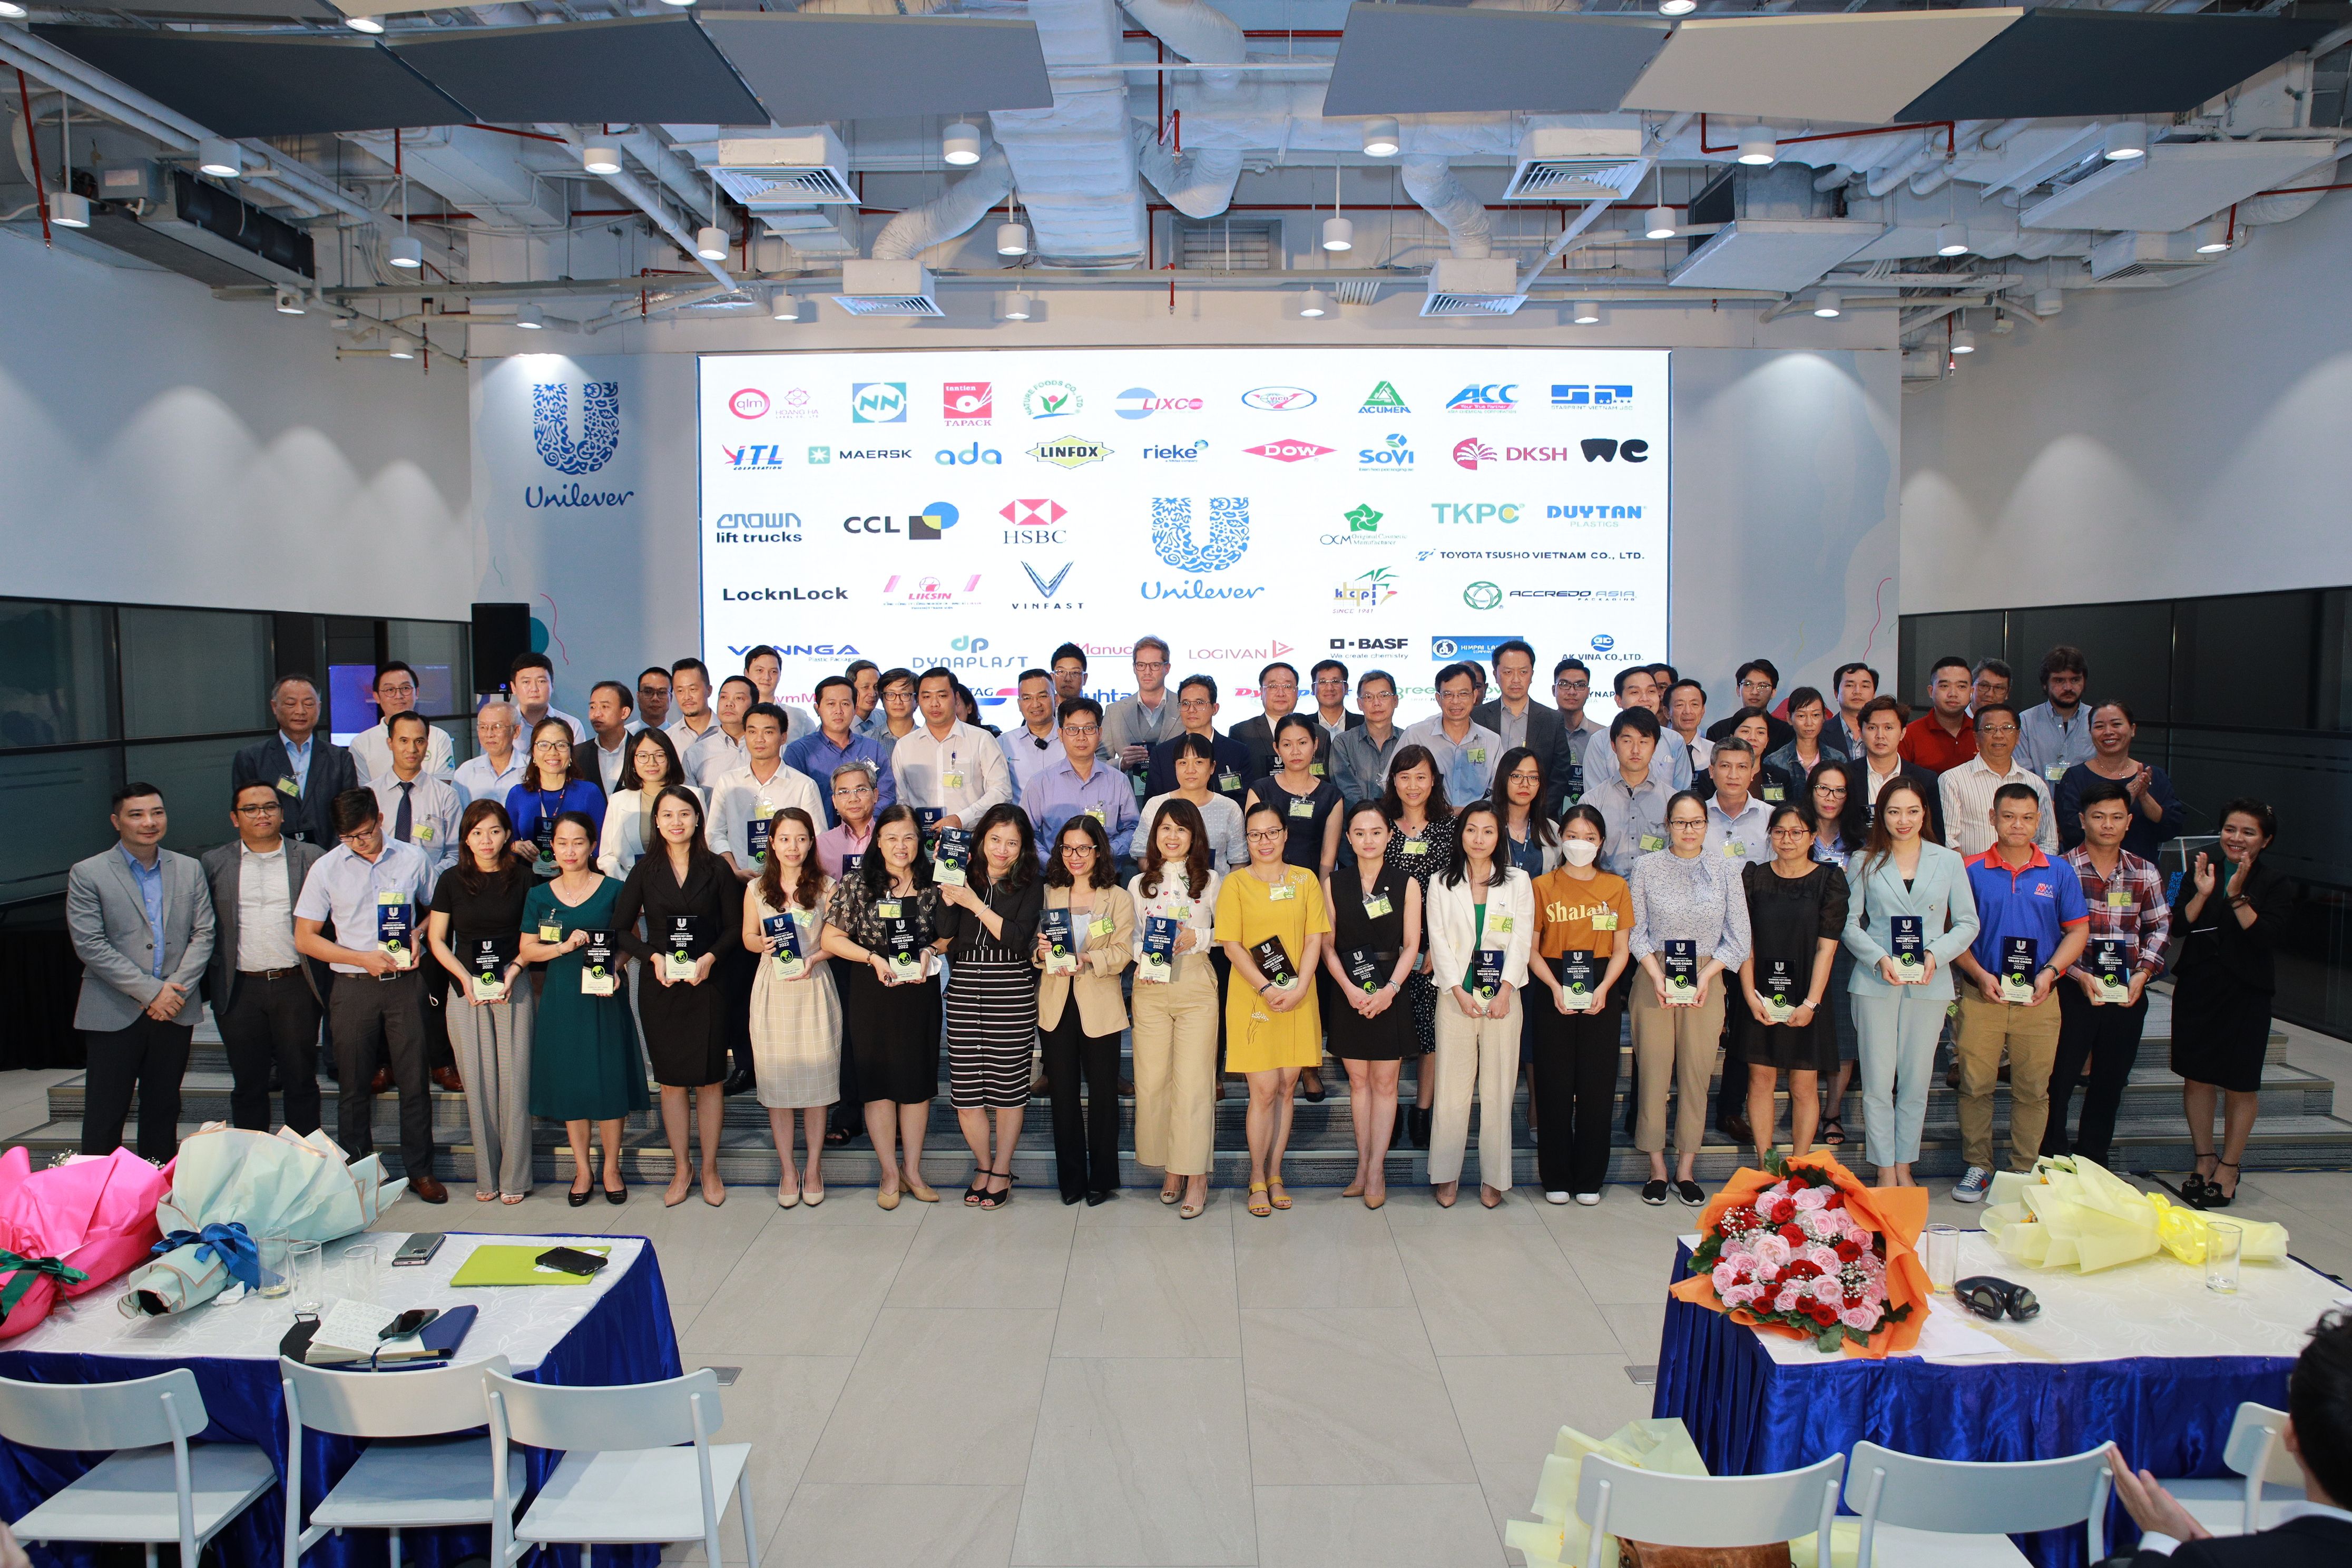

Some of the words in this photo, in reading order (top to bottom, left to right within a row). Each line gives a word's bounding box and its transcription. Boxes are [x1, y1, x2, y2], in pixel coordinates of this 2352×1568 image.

[1033, 380, 1063, 390] FOODS
[1446, 384, 1520, 404] ACC
[840, 449, 912, 459] MAERSK
[935, 442, 1002, 465] ada
[1041, 447, 1099, 457] LINFOX
[1143, 445, 1198, 458] rieke
[1506, 447, 1567, 461] DKSH
[526, 483, 634, 508] Unilever
[1431, 503, 1520, 524] TKPC
[1547, 506, 1642, 519] DUYTAN
[844, 516, 900, 534] CCL
[717, 532, 739, 543] lift
[743, 531, 803, 543] trucks
[1003, 530, 1067, 544] HSBC
[1591, 552, 1615, 560] CO.,
[723, 587, 848, 601] LocknLock
[1141, 580, 1265, 599] Unilever
[728, 645, 860, 655] VNNGA
[1358, 638, 1408, 649] BASF
[1189, 649, 1267, 659] LOGIVAN
[913, 656, 1028, 668] DYNAPLAST
